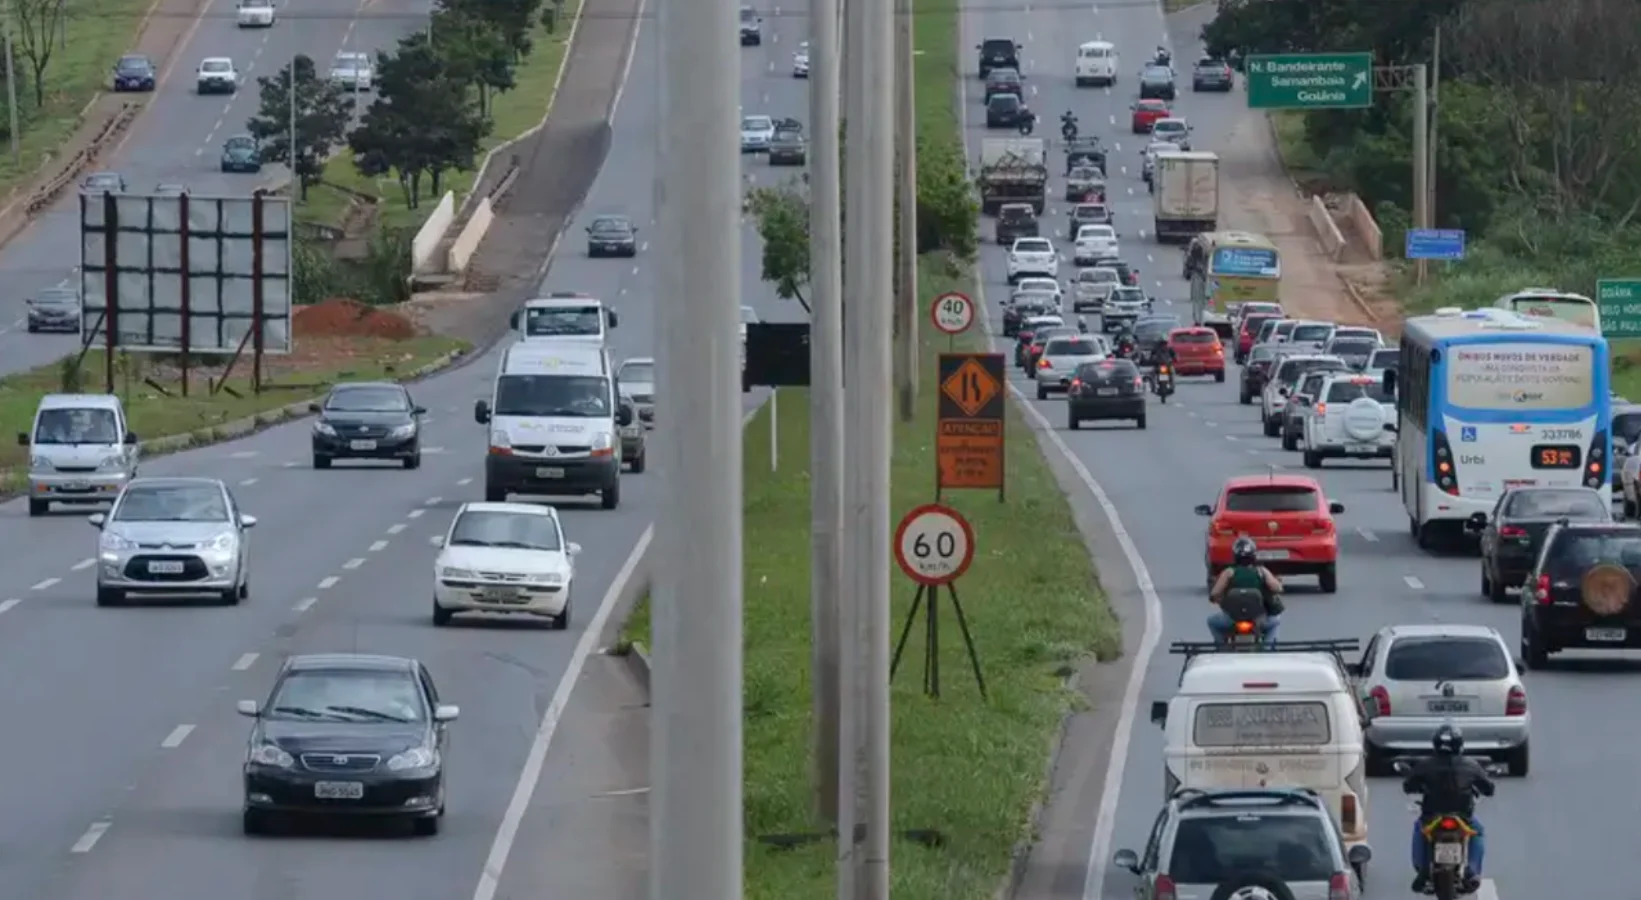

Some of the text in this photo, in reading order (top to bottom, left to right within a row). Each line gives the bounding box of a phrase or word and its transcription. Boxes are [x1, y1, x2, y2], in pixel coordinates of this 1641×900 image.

[1250, 61, 1346, 73] N. Bandeirante
[1271, 75, 1346, 87] Samambaia
[1296, 90, 1347, 102] Goiânia
[943, 299, 964, 314] 40
[1460, 455, 1485, 465] Urbi
[913, 531, 955, 558] 60
[919, 561, 950, 571] km/h
